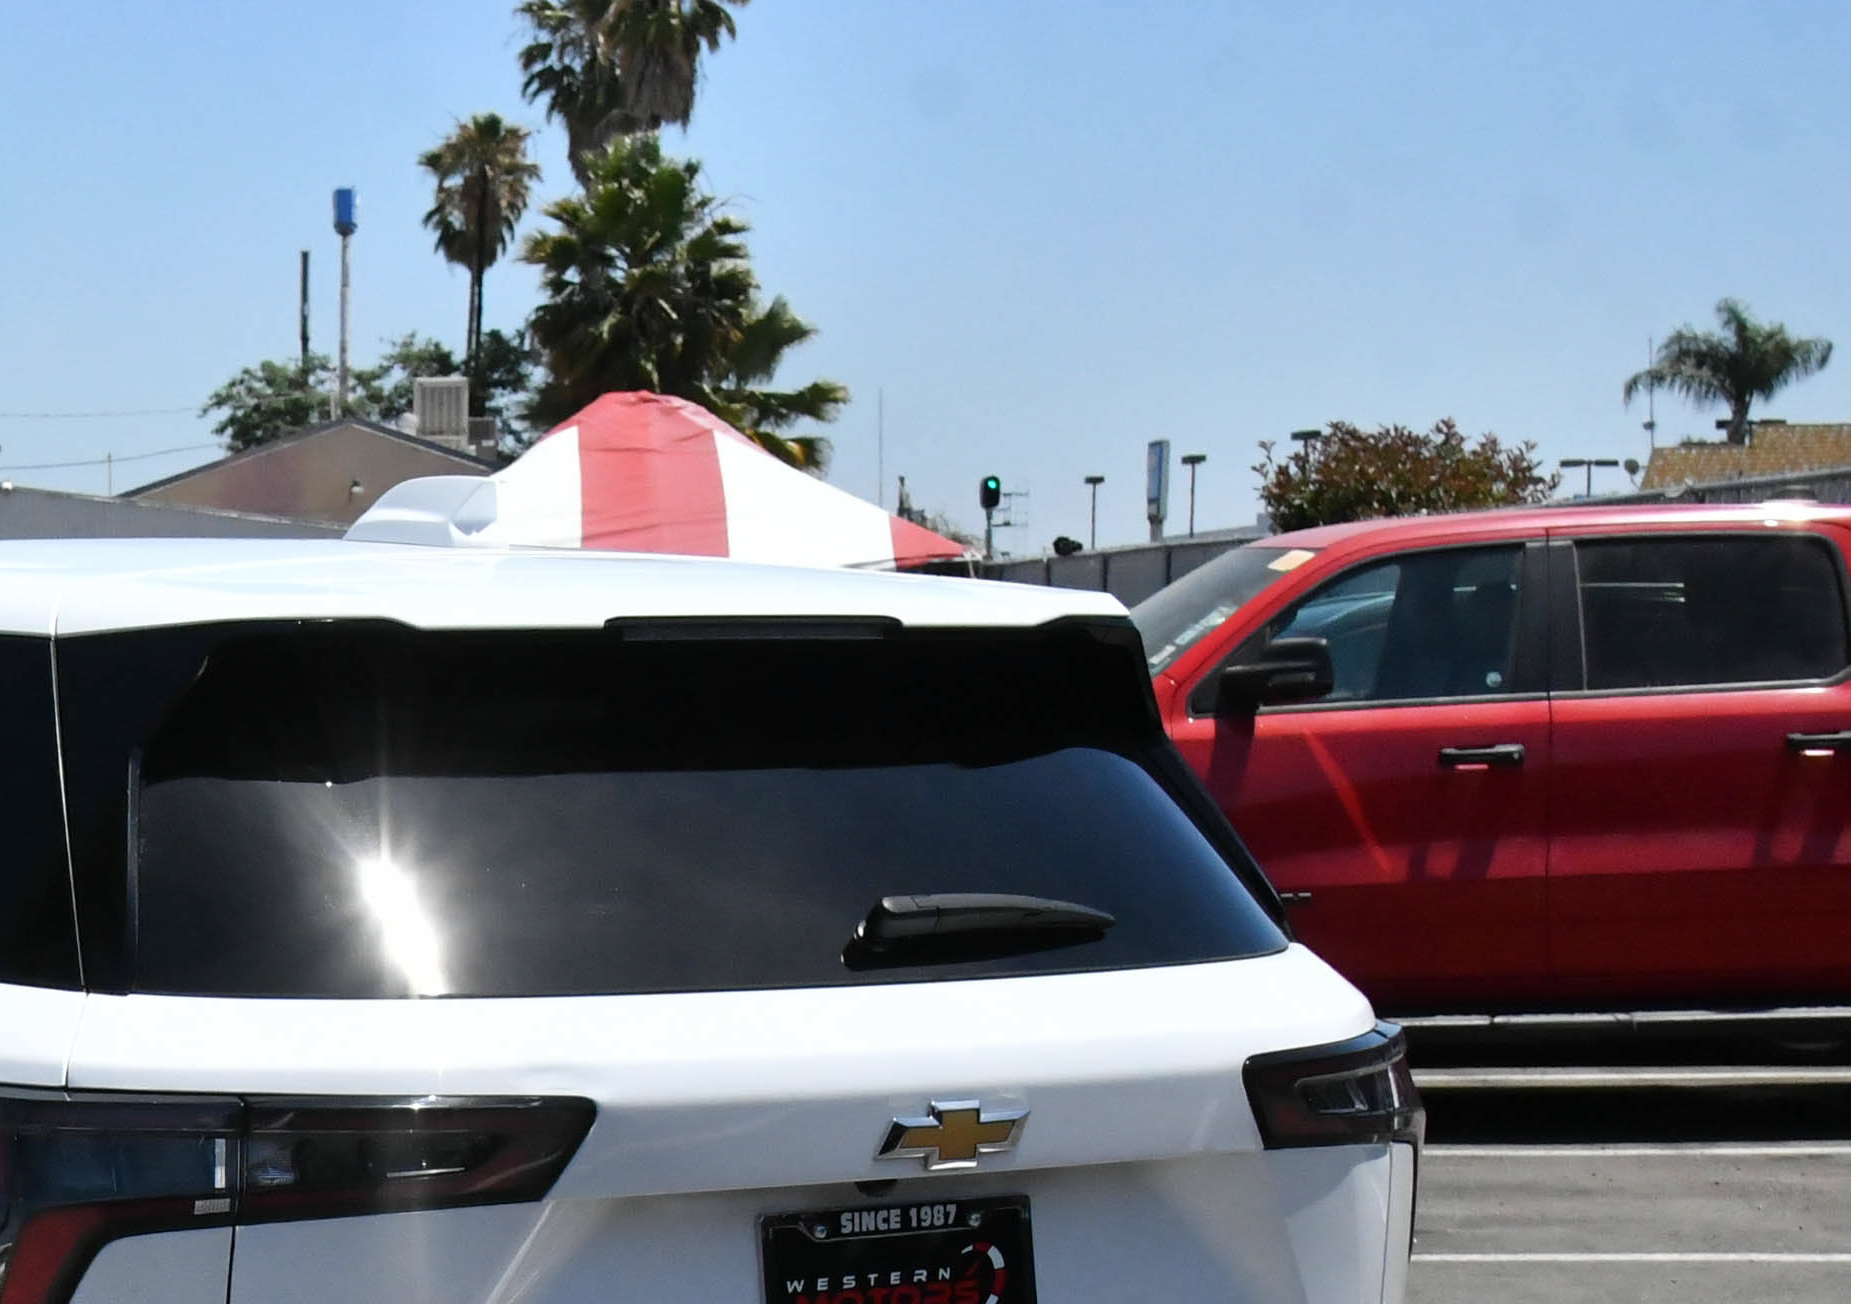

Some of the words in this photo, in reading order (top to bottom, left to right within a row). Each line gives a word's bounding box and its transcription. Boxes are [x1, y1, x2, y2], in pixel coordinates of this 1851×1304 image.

[840, 1208, 901, 1234] SINCE
[909, 1204, 957, 1227] 1987
[786, 1266, 951, 1294] WESTERN
